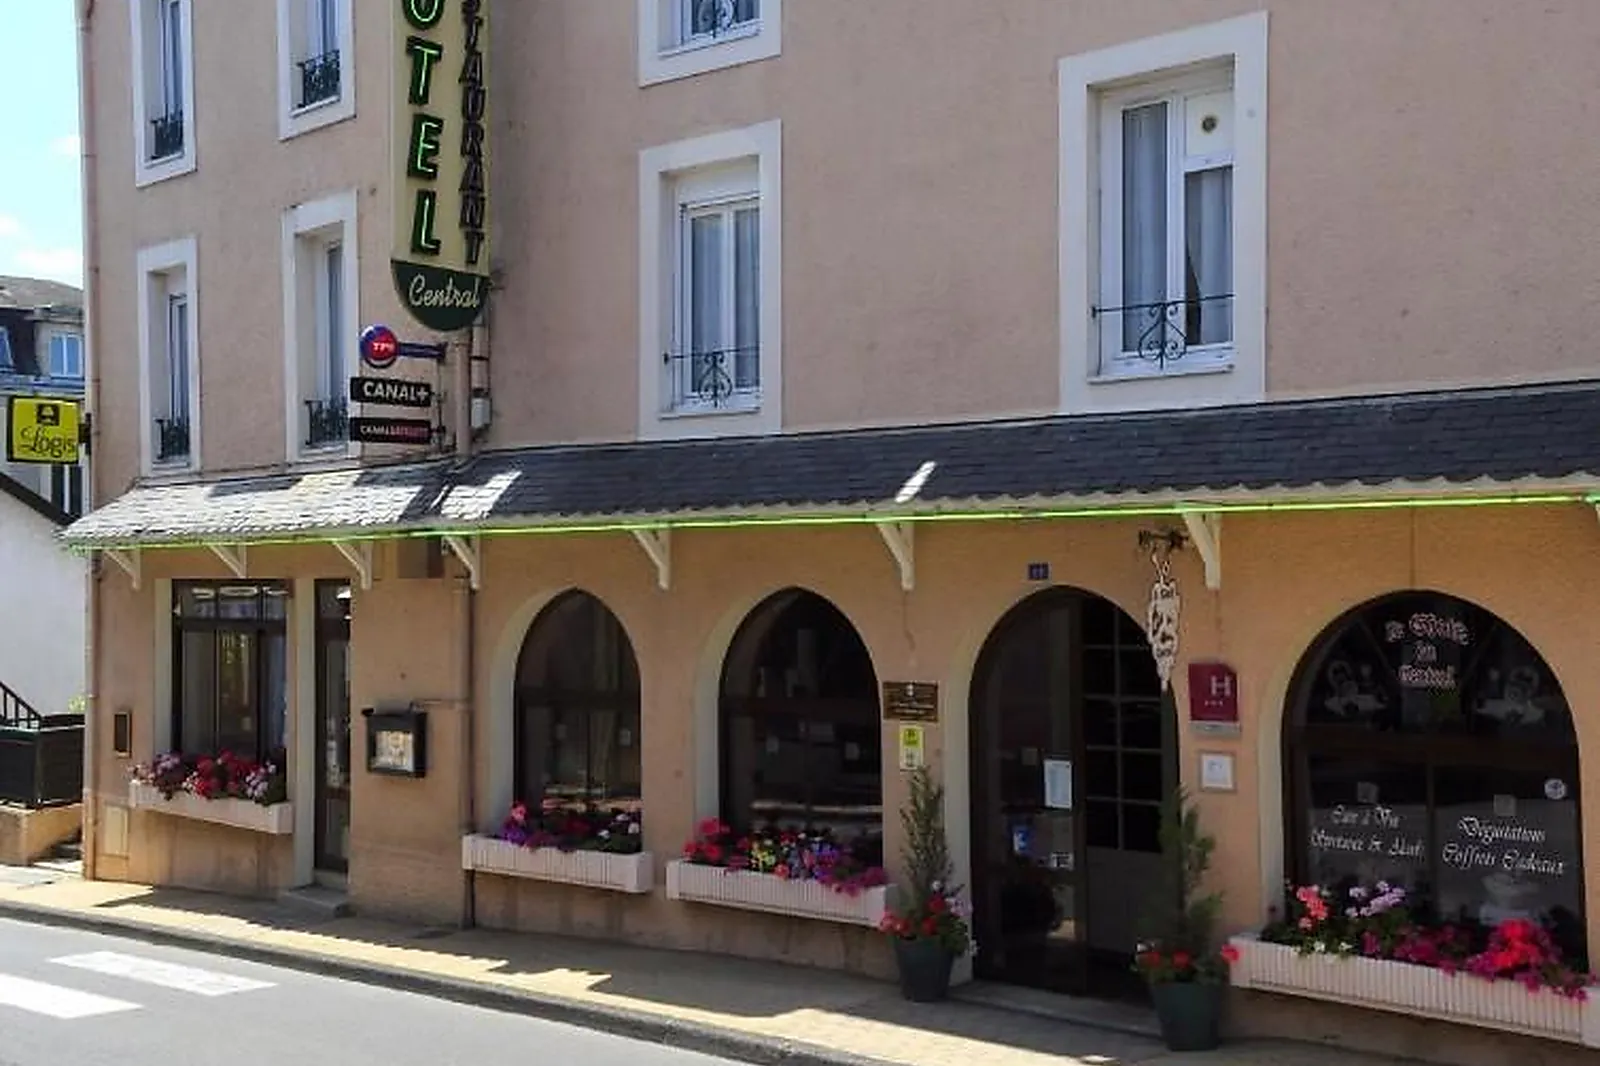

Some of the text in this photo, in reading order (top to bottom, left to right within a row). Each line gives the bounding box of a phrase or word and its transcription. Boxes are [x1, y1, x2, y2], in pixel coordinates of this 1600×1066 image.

[408, 273, 481, 307] Central
[363, 381, 429, 402] CANAL+
[20, 425, 76, 458] Logis
[1211, 675, 1231, 696] H
